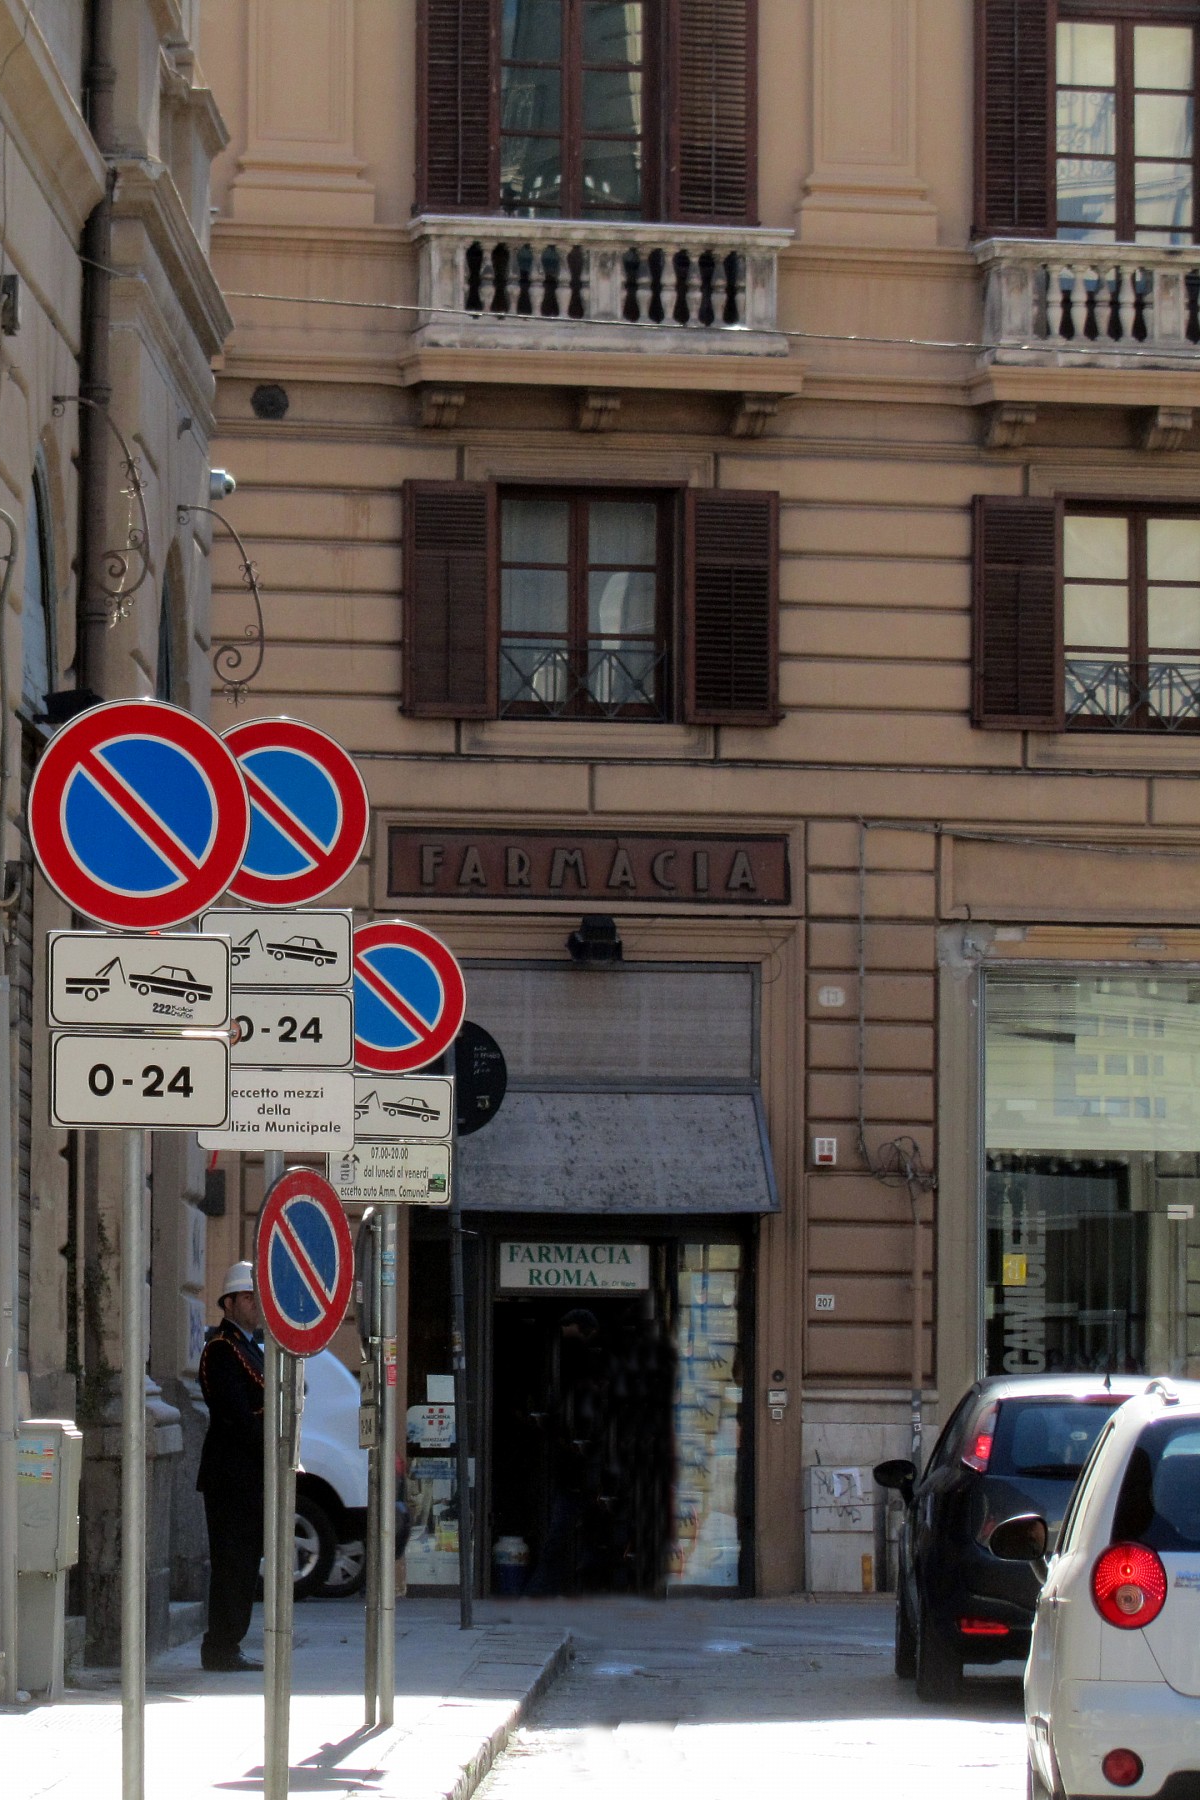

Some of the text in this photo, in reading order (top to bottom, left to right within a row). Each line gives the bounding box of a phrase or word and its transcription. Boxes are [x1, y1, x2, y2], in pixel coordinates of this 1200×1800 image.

[419, 843, 757, 892] FARMACIA
[152, 1002, 171, 1015] 222
[231, 1087, 324, 1098] eccetto mezzi
[257, 1104, 291, 1116] della
[231, 1121, 341, 1136] lizia Municipale
[363, 1165, 374, 1178] dal
[396, 1166, 403, 1179] al
[341, 1185, 361, 1196] eccetto
[363, 1186, 377, 1196] auto
[399, 1186, 430, 1198] Comunale
[508, 1244, 631, 1264] FARMACIA
[528, 1268, 598, 1286] ROMA
[817, 1297, 833, 1307] 207
